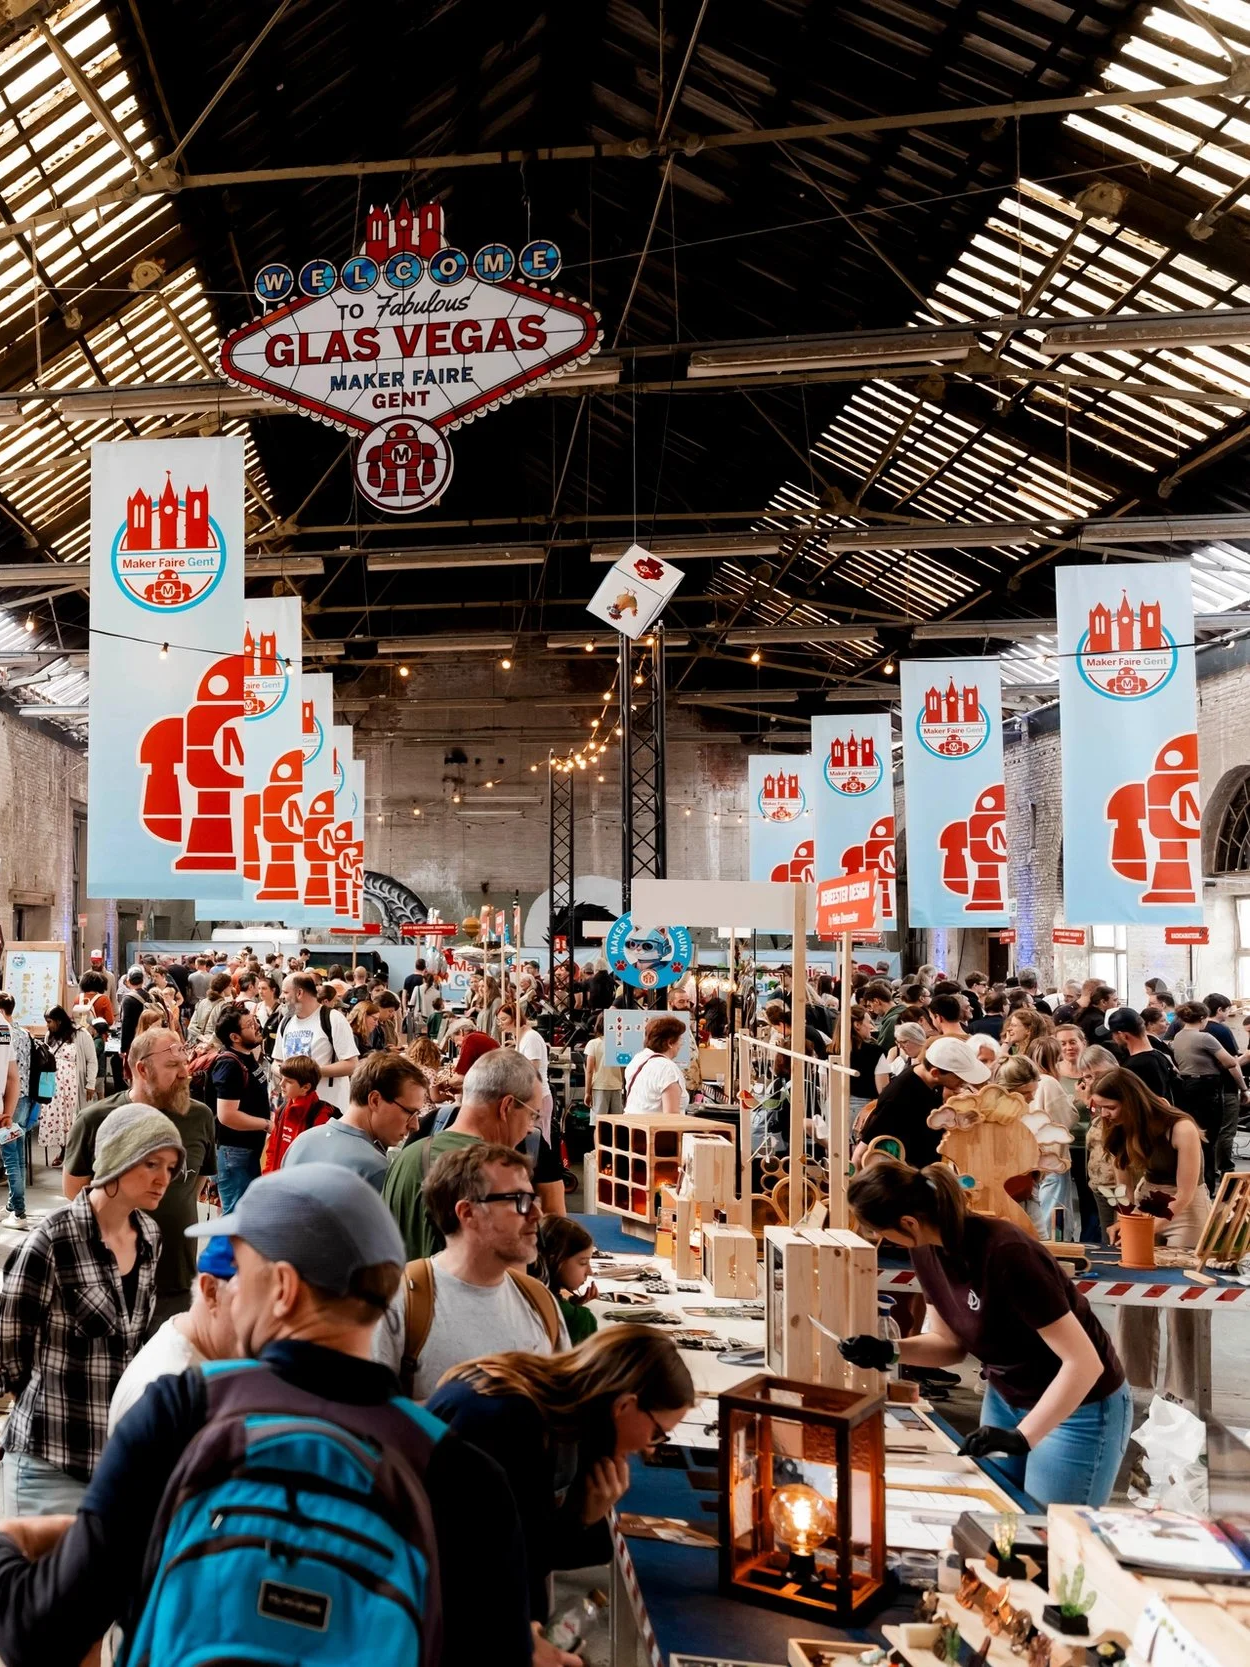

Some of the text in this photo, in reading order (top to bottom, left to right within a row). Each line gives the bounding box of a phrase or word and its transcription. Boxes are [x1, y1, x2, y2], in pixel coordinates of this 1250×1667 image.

[263, 250, 548, 291] WELCOME
[336, 289, 470, 321] TO Fabulous
[264, 314, 548, 369] GLAS VEGAS
[330, 366, 474, 392] MAKER FAIRE
[372, 390, 431, 410] GENT
[122, 556, 215, 569] Maker Faire Gent
[1086, 657, 1167, 667] Maker Faire Gent
[610, 921, 689, 959] MAKER HUNT
